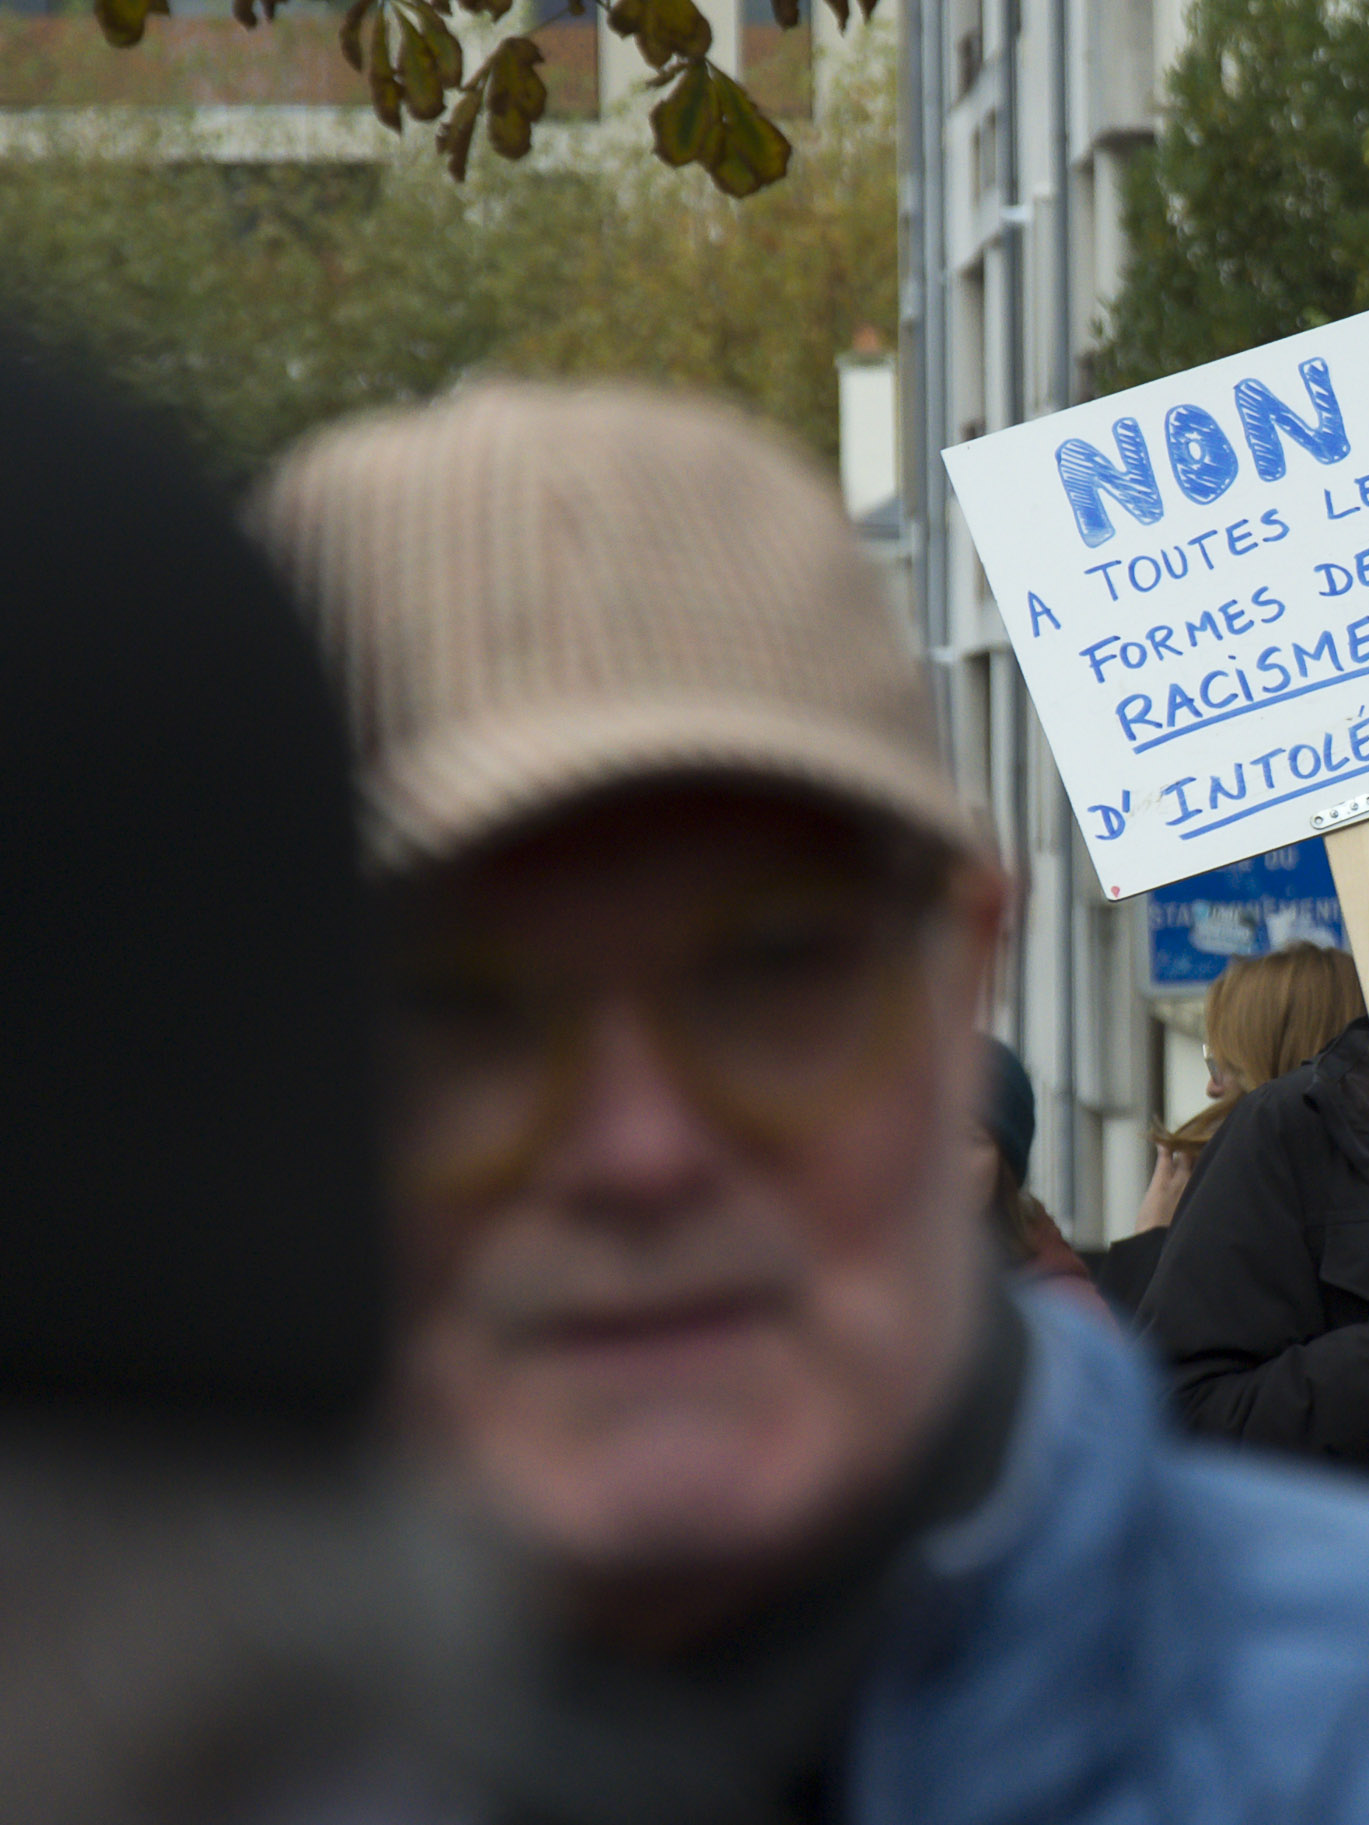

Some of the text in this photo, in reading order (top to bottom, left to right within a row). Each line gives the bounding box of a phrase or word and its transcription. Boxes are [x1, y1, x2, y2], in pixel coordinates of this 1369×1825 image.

[1054, 356, 1352, 550] NON
[1027, 591, 1063, 639] A
[1084, 508, 1291, 602] TOUTES
[1079, 585, 1287, 685] FORMES
